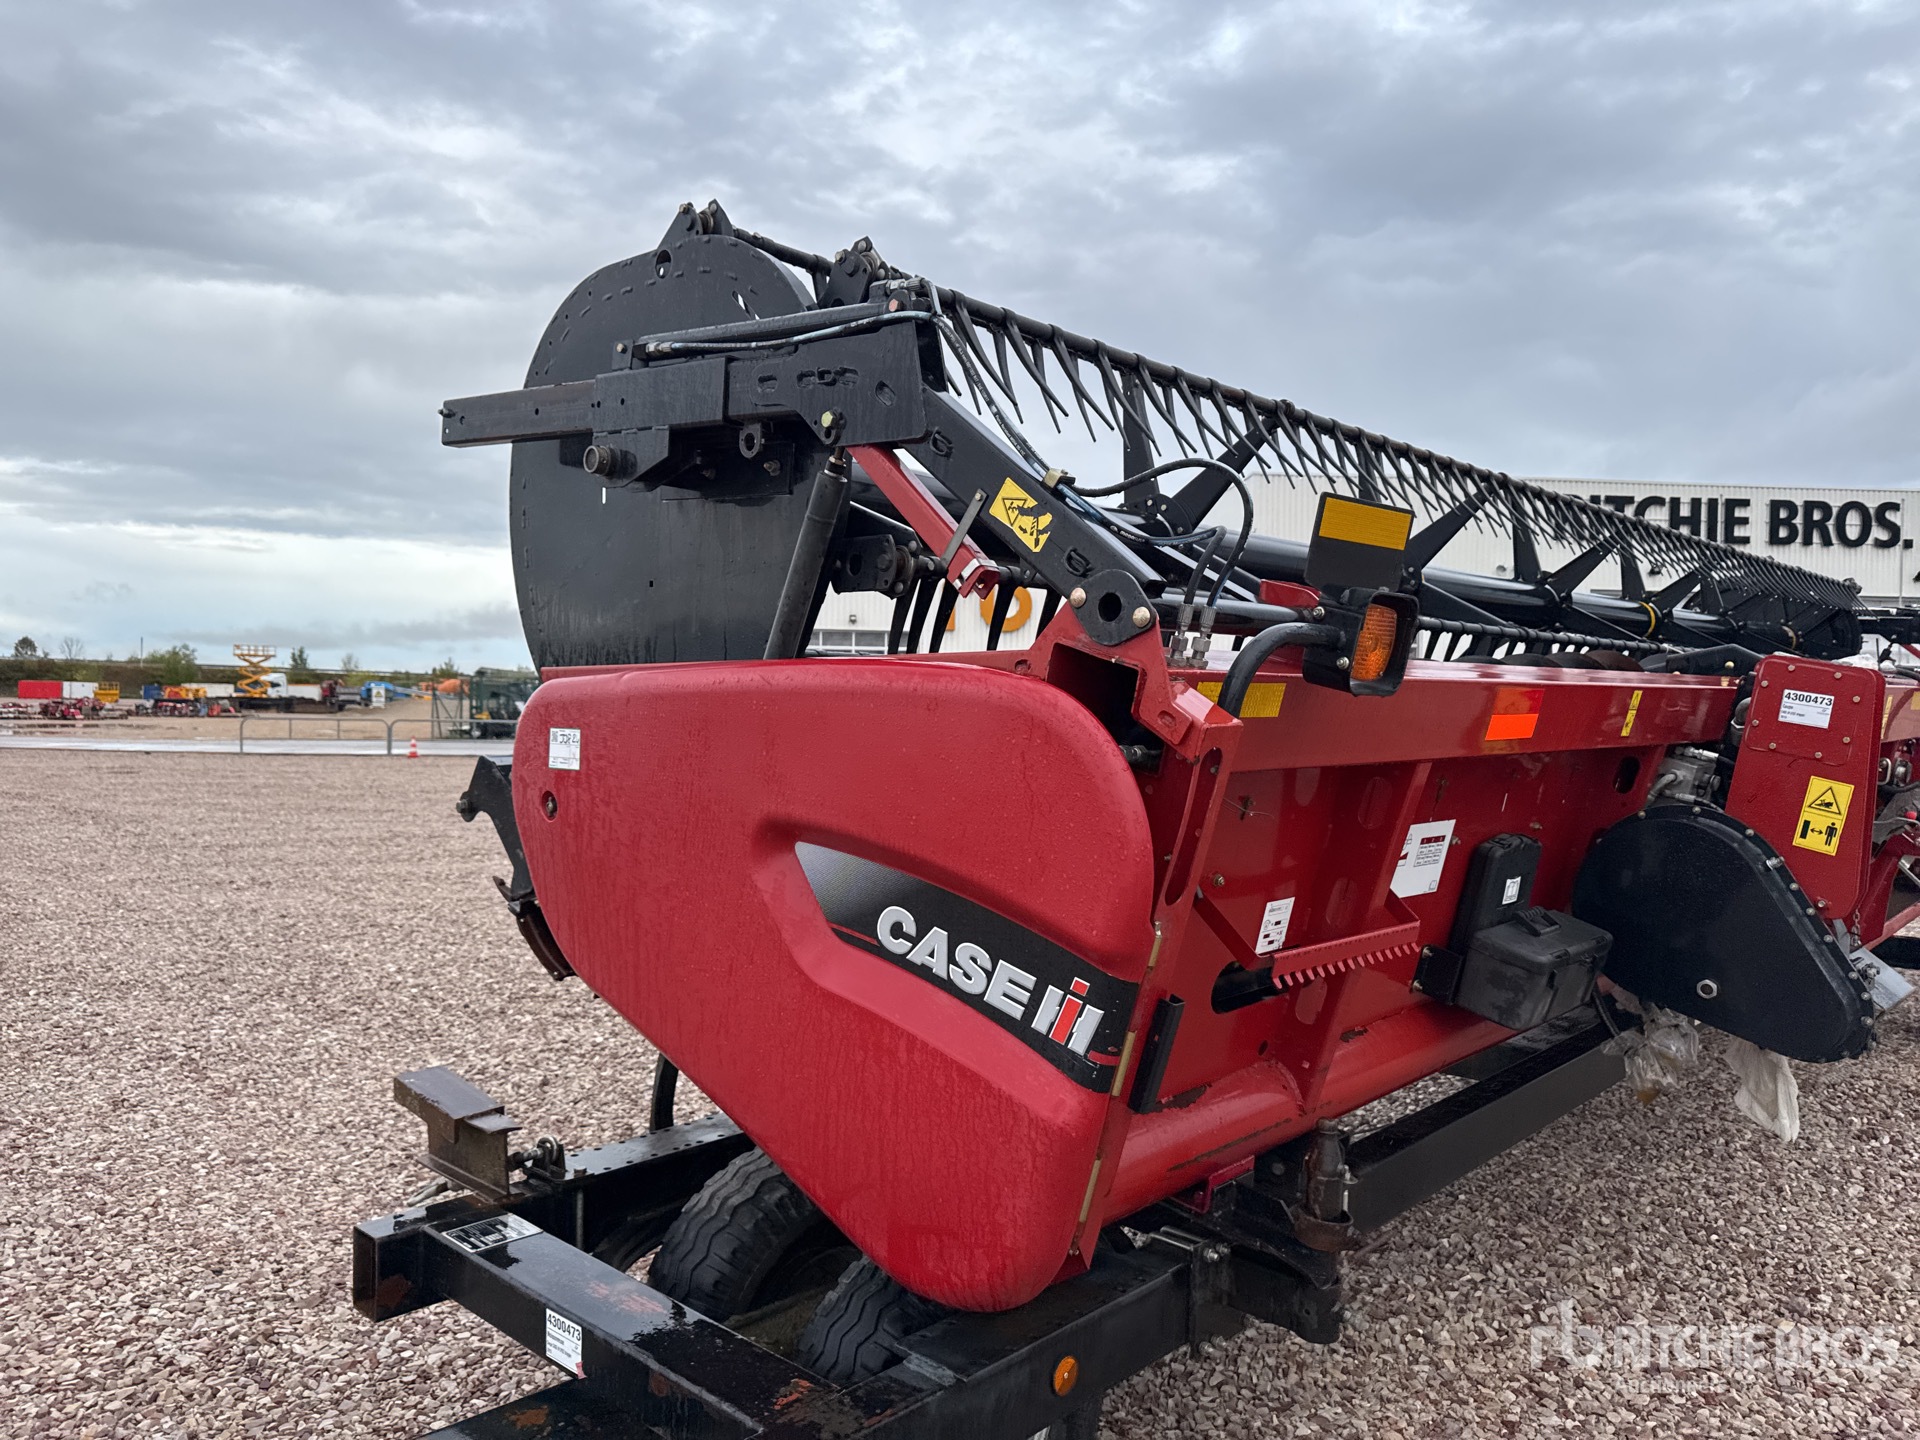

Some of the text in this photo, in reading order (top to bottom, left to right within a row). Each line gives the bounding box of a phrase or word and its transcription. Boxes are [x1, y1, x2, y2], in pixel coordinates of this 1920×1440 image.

[1769, 499, 1914, 549] BROS.
[1785, 692, 1833, 706] 4300473
[876, 905, 1037, 1021] CASE
[547, 1313, 581, 1342] 4300473
